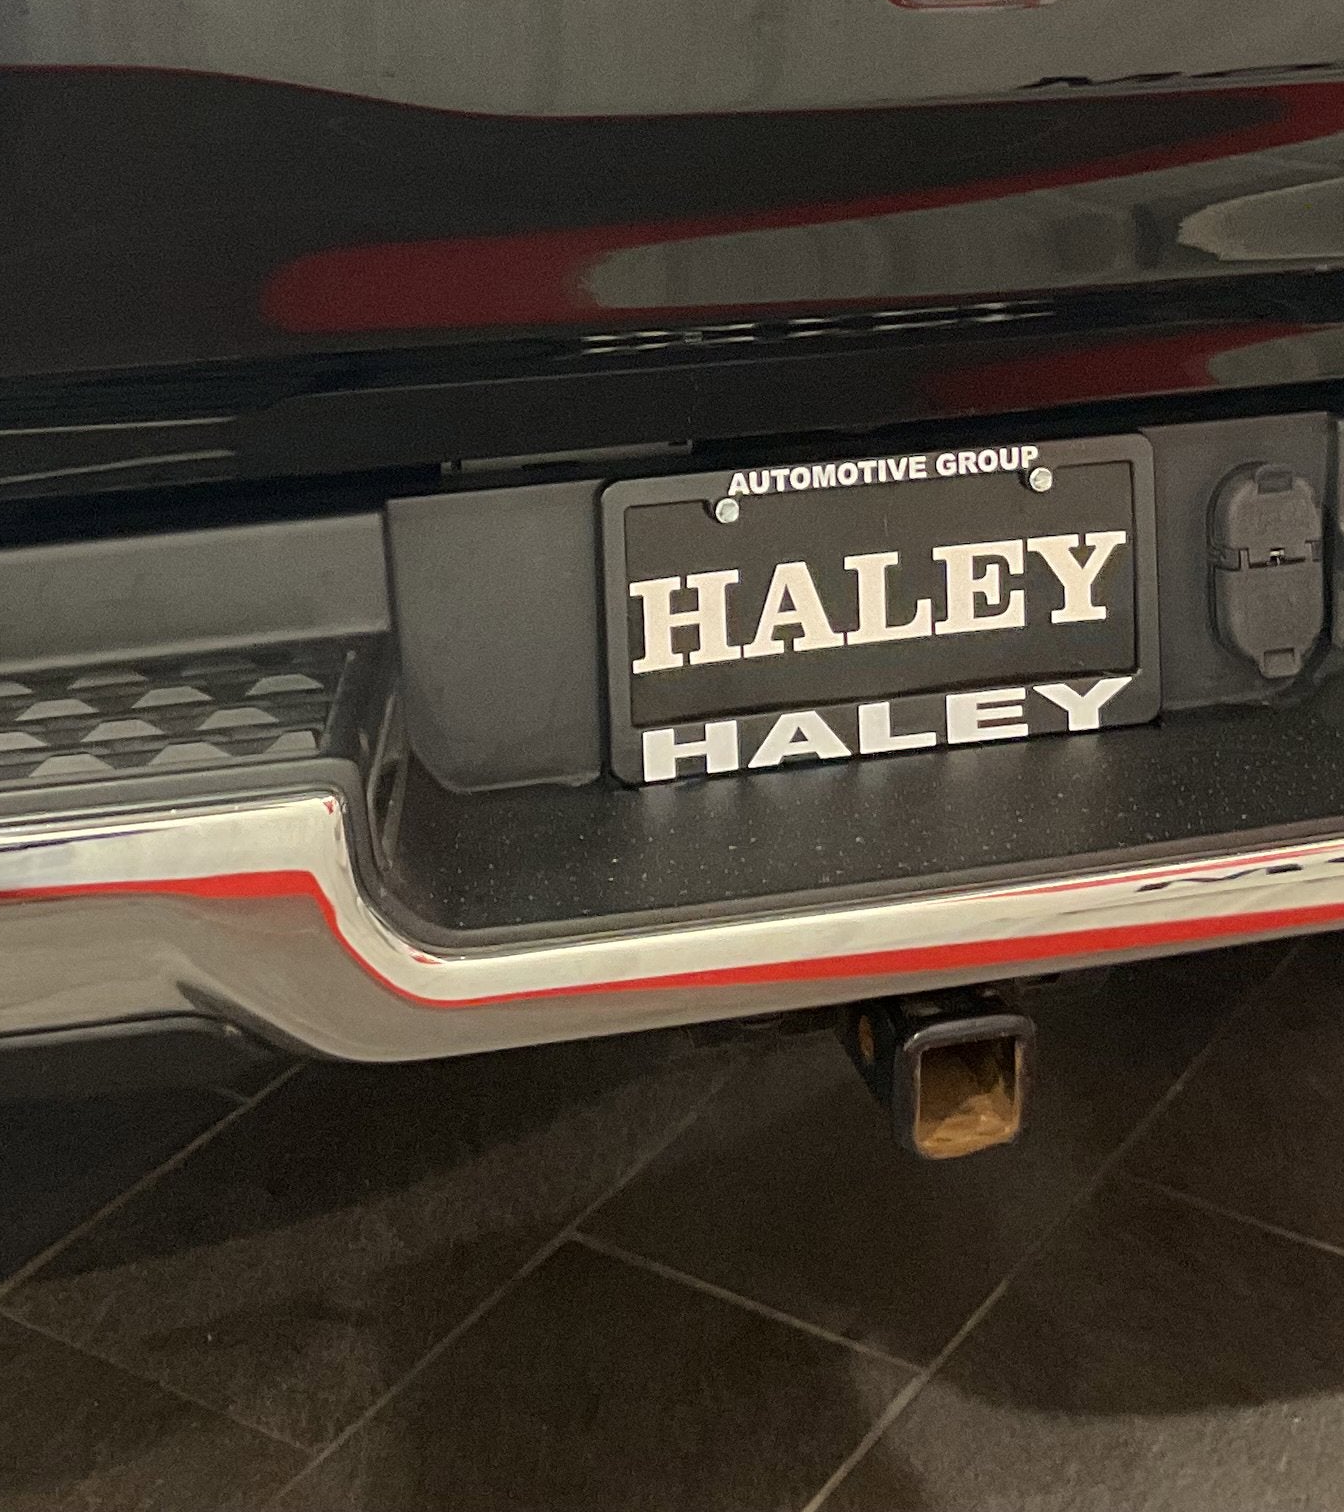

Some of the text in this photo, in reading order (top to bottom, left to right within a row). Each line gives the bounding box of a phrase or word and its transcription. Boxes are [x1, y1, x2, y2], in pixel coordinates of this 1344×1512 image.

[727, 445, 1040, 496] AUTOMOTIVE GROUP
[629, 530, 1127, 675] HALEY
[642, 676, 1133, 783] HALEY
